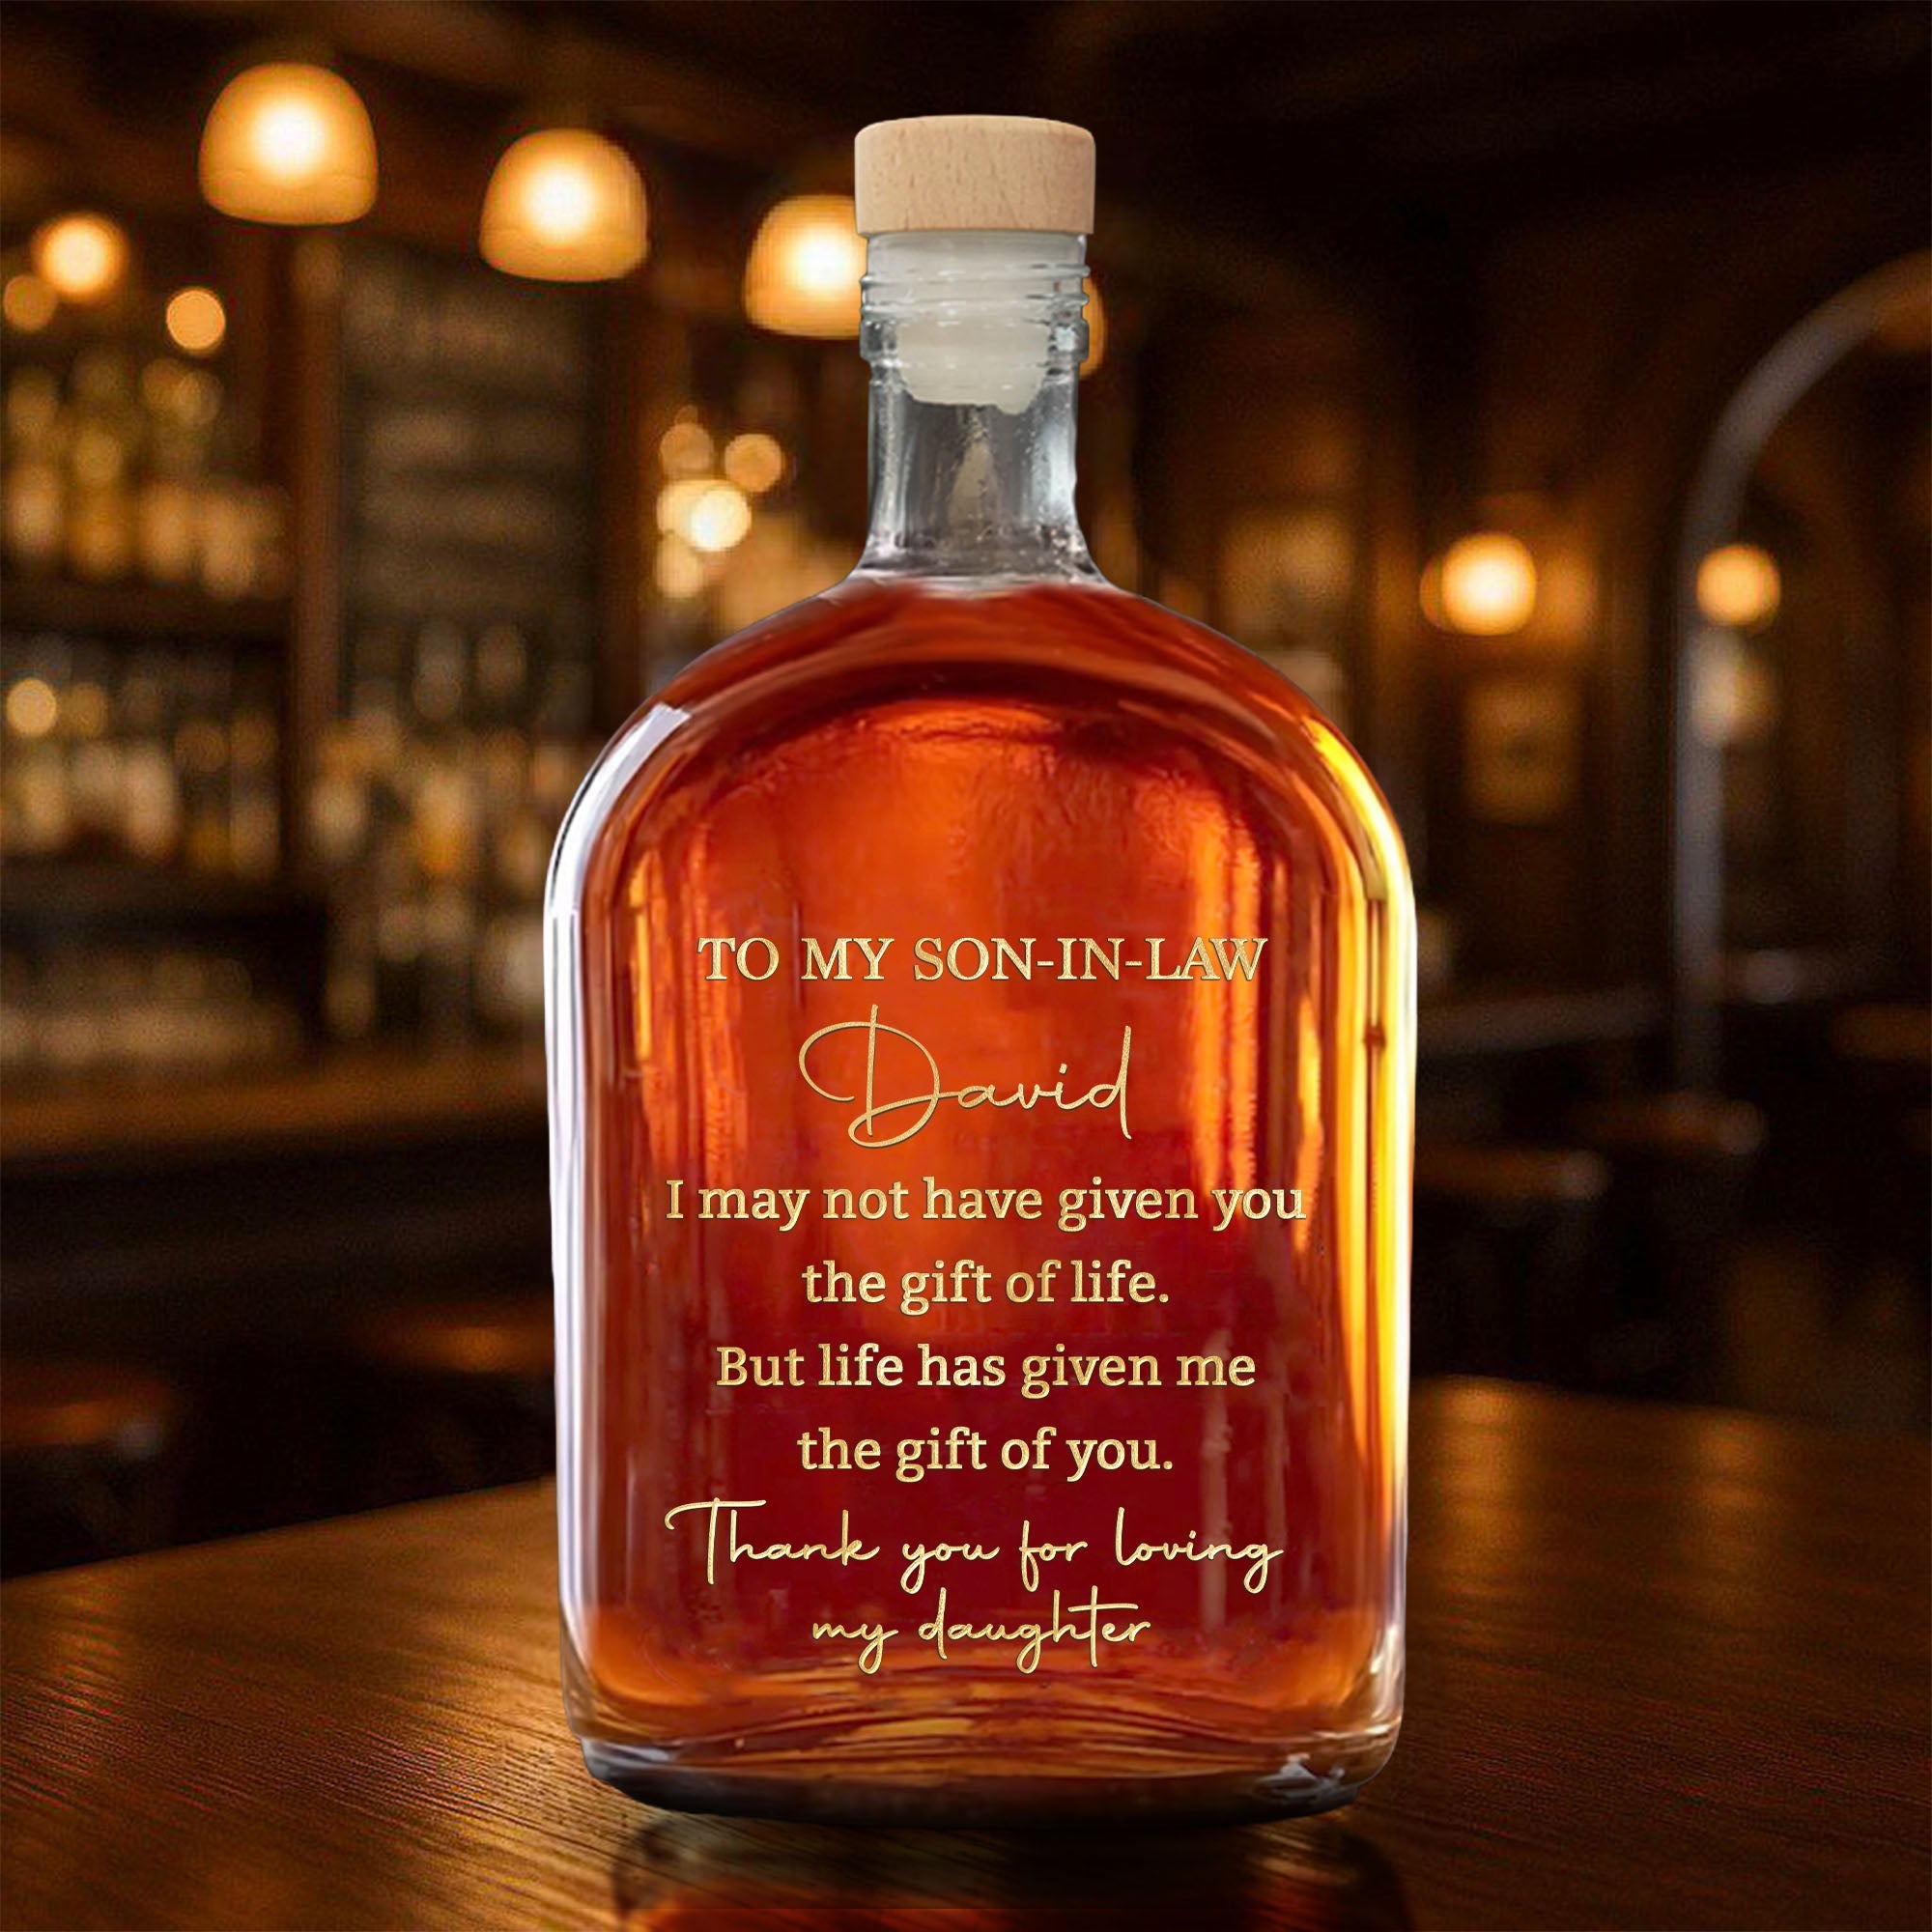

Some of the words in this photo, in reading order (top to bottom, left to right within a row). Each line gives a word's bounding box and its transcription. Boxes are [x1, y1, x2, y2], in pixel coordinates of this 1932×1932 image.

[696, 937, 779, 980] TO
[801, 937, 894, 980] MY
[914, 937, 1267, 981] SON-IN-LAW
[799, 1005, 1131, 1148] David
[666, 1179, 683, 1219] I
[698, 1187, 810, 1232] may
[823, 1180, 909, 1220] not
[922, 1178, 1042, 1220] have
[1058, 1178, 1198, 1233] given
[1211, 1189, 1306, 1233] you
[802, 1261, 886, 1303] the
[900, 1260, 991, 1315] gift
[1006, 1261, 1057, 1303] of
[1070, 1261, 1170, 1303] life.
[716, 1347, 804, 1386] But
[818, 1344, 903, 1386] life
[919, 1344, 1006, 1386] has
[1021, 1344, 1160, 1399] given
[1177, 1354, 1256, 1386] me
[798, 1427, 881, 1469] the
[895, 1427, 986, 1482] gift
[1002, 1428, 1056, 1469] of
[1066, 1438, 1173, 1482] you.
[665, 1498, 880, 1584] Thank
[900, 1544, 999, 1593] you
[1019, 1520, 1088, 1591] for
[1115, 1507, 1284, 1593] loving
[813, 1621, 897, 1673] my
[918, 1586, 1151, 1674] daughter
